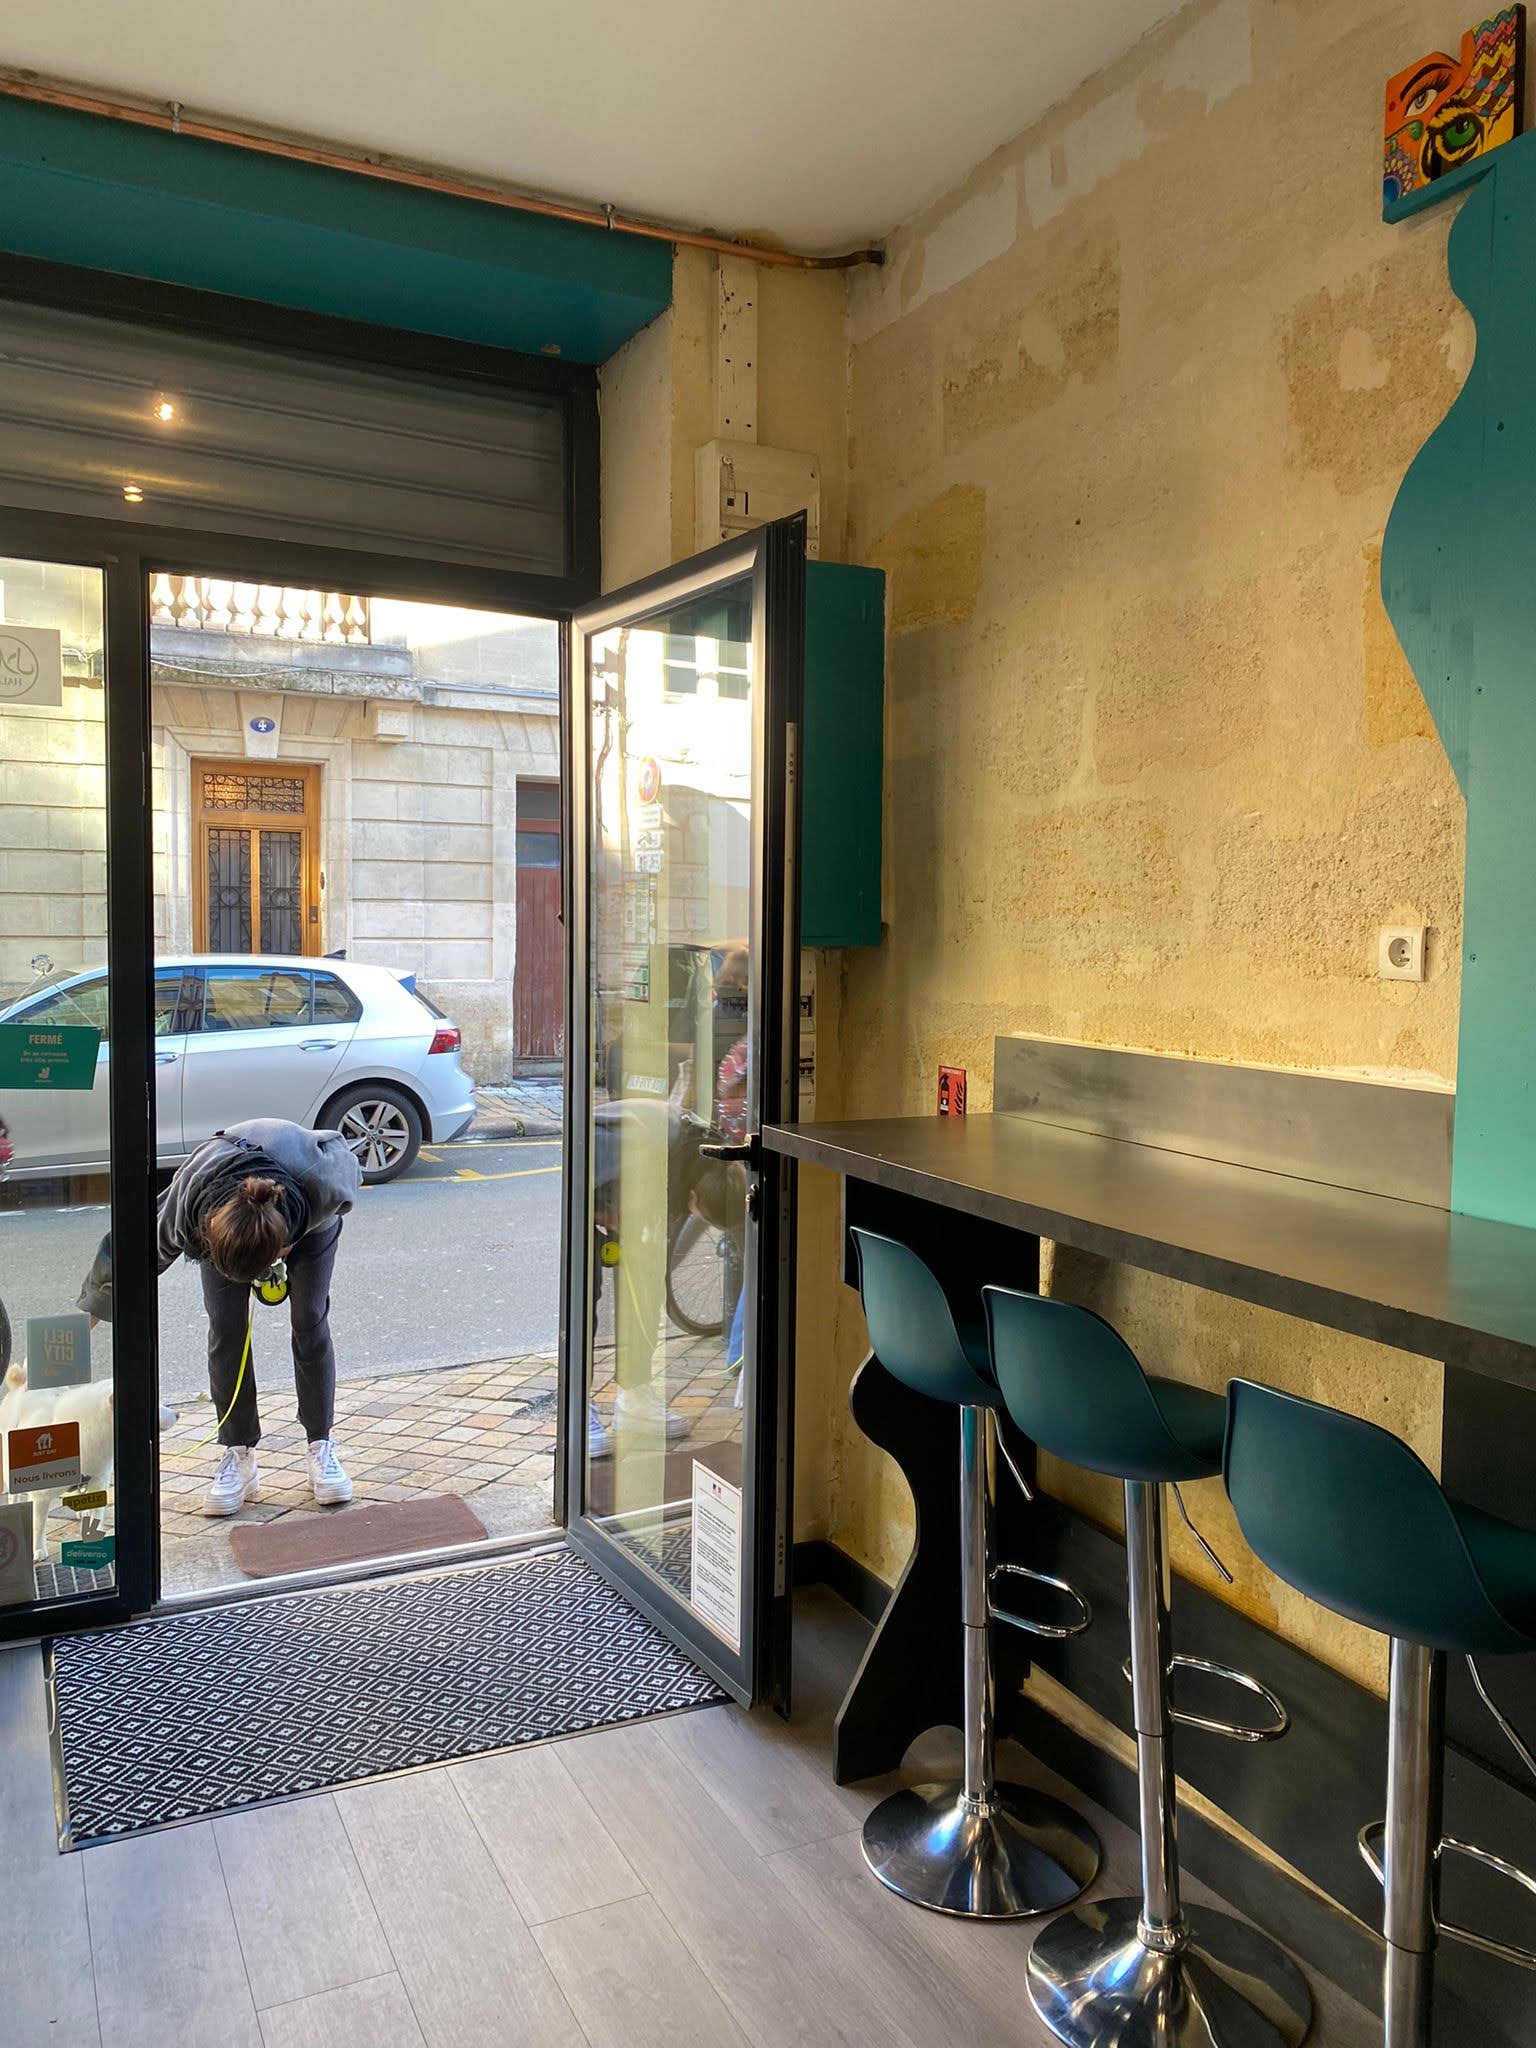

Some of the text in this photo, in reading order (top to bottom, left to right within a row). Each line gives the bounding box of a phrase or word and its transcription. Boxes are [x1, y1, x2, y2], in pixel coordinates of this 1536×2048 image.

[258, 720, 267, 731] 4
[29, 1033, 63, 1045] FERMÉ
[14, 1469, 77, 1485] Nous livrons
[66, 1549, 108, 1558] deliveroo
